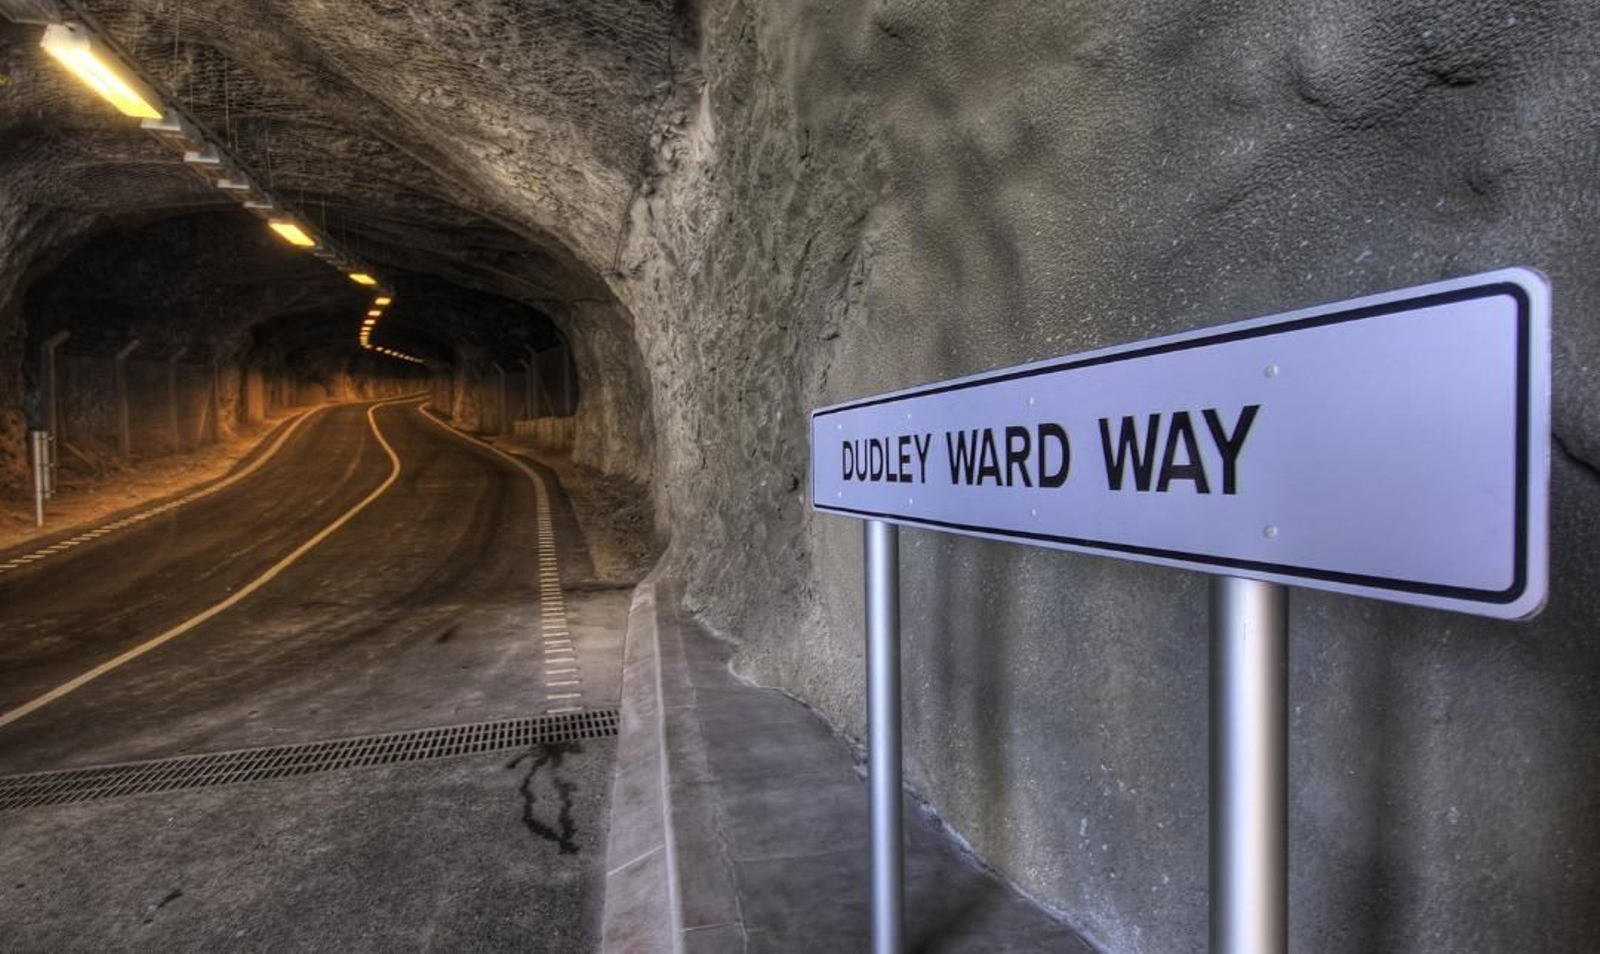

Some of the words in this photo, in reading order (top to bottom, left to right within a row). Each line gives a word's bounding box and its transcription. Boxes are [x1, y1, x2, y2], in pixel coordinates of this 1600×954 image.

[842, 433, 933, 484] DUDLEY
[946, 422, 1071, 489] WARD
[1098, 404, 1261, 496] WAY
